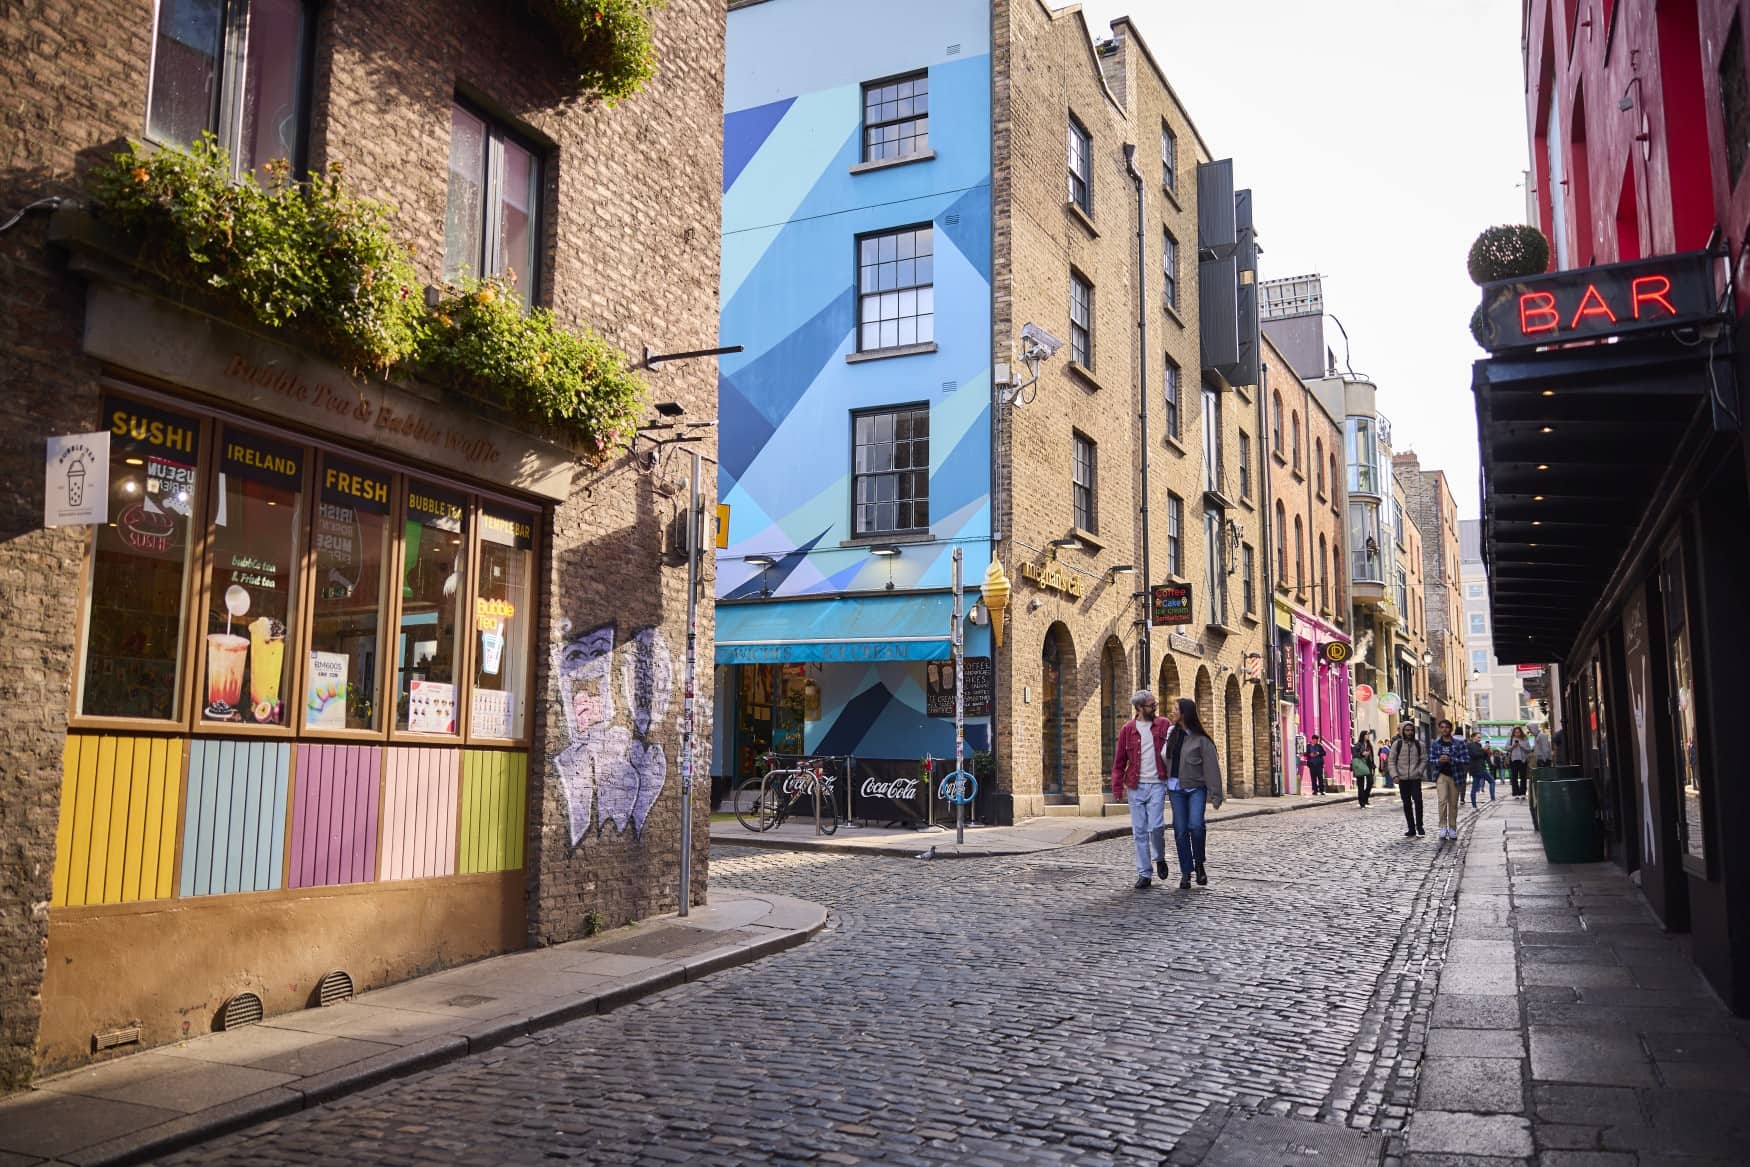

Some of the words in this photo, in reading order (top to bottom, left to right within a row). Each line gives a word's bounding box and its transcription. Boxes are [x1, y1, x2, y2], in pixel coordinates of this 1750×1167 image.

[1519, 274, 1677, 334] BAR
[312, 384, 351, 416] Tea
[111, 410, 193, 453] SUSHI
[227, 443, 297, 476] IRELAND
[325, 468, 388, 504] FRESH
[408, 493, 446, 516] BUBBLE
[446, 503, 463, 521] TEA
[483, 514, 515, 535] TEMPLE
[515, 521, 531, 539] BAR
[129, 531, 169, 552] SUSHI
[231, 554, 262, 570] bubble
[262, 560, 277, 573] tea
[231, 570, 240, 583] &
[261, 576, 276, 589] tea
[1155, 587, 1187, 598] Coffee
[1162, 599, 1181, 608] Cake
[1284, 645, 1293, 689] VINTAGE
[860, 776, 920, 800] Coca-Cola
